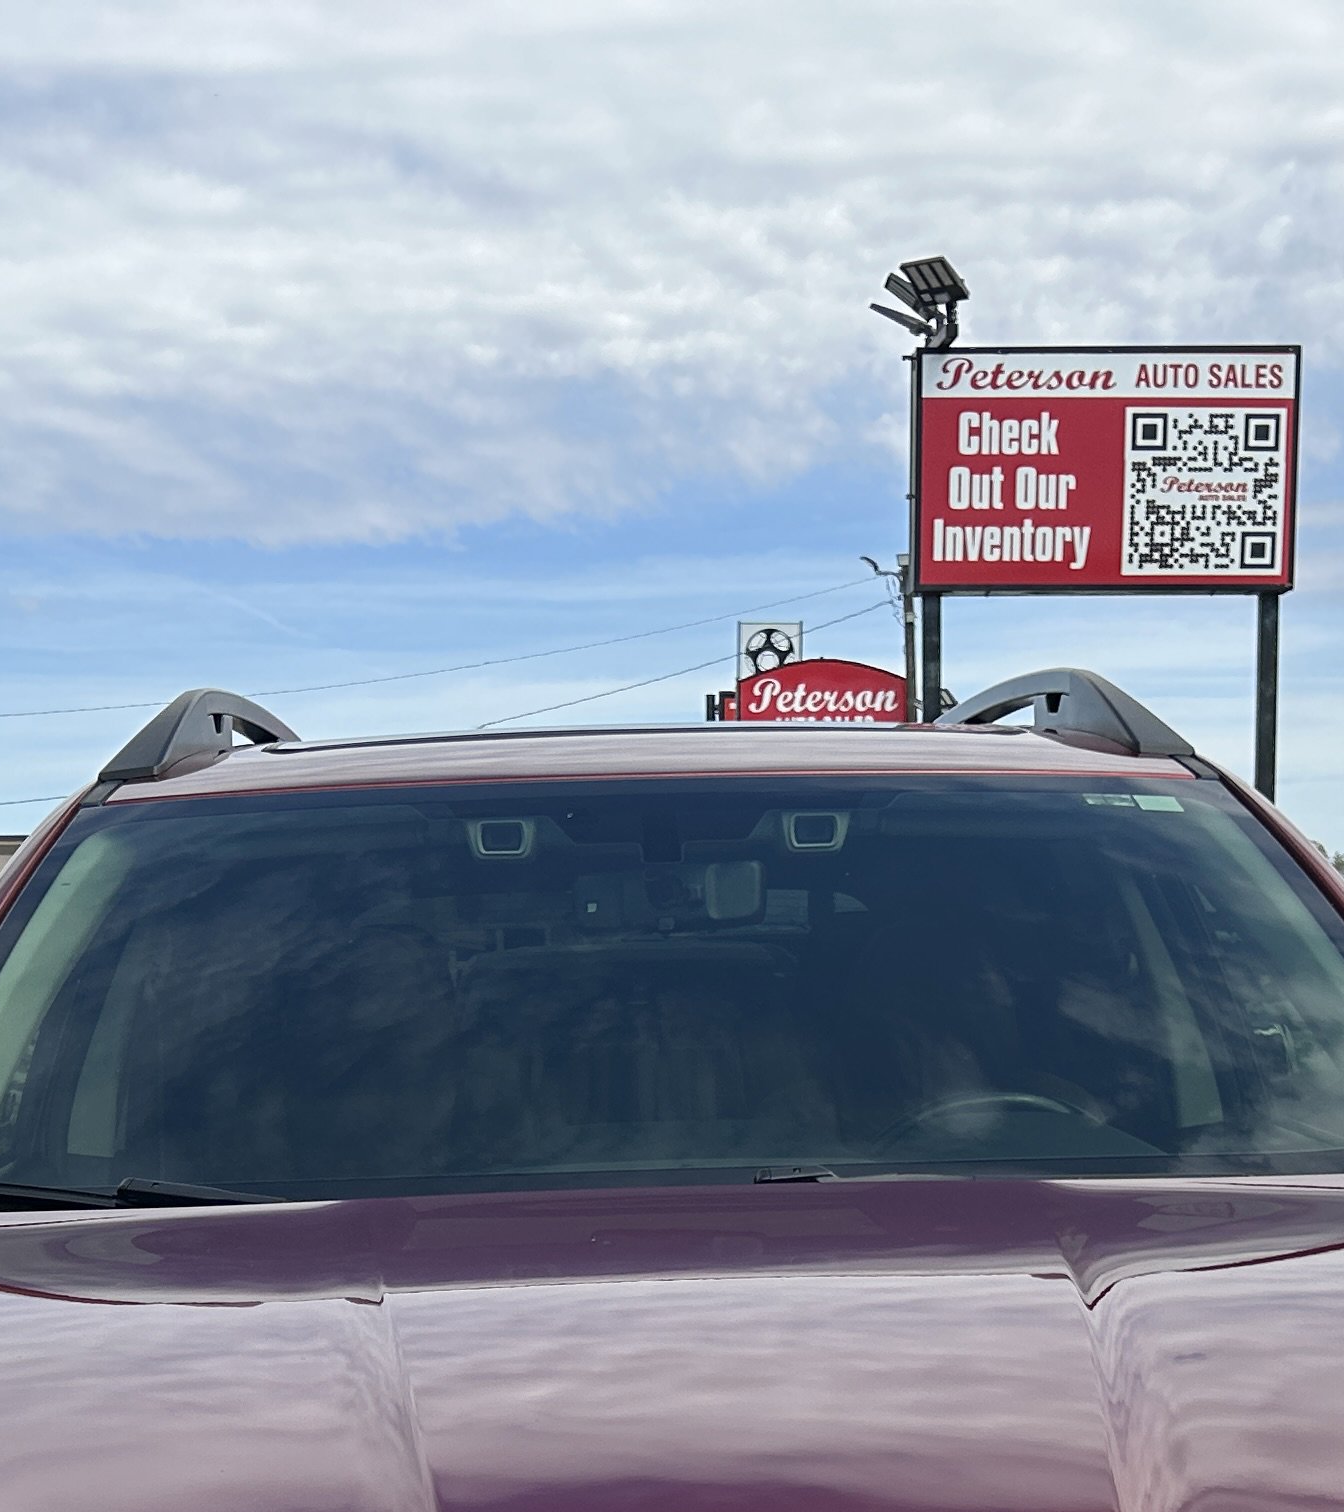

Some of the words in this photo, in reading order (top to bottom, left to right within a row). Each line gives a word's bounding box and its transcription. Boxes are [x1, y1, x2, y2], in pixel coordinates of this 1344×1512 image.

[936, 357, 1117, 392] Peterson
[1135, 364, 1199, 388] AUTO
[1208, 364, 1284, 388] SALES
[959, 411, 1060, 455] Check
[949, 466, 1004, 510] Out
[1016, 466, 1076, 510] Our
[1160, 476, 1248, 493] Peterson
[932, 519, 1091, 569] Inventory
[748, 678, 899, 713] Peterson
